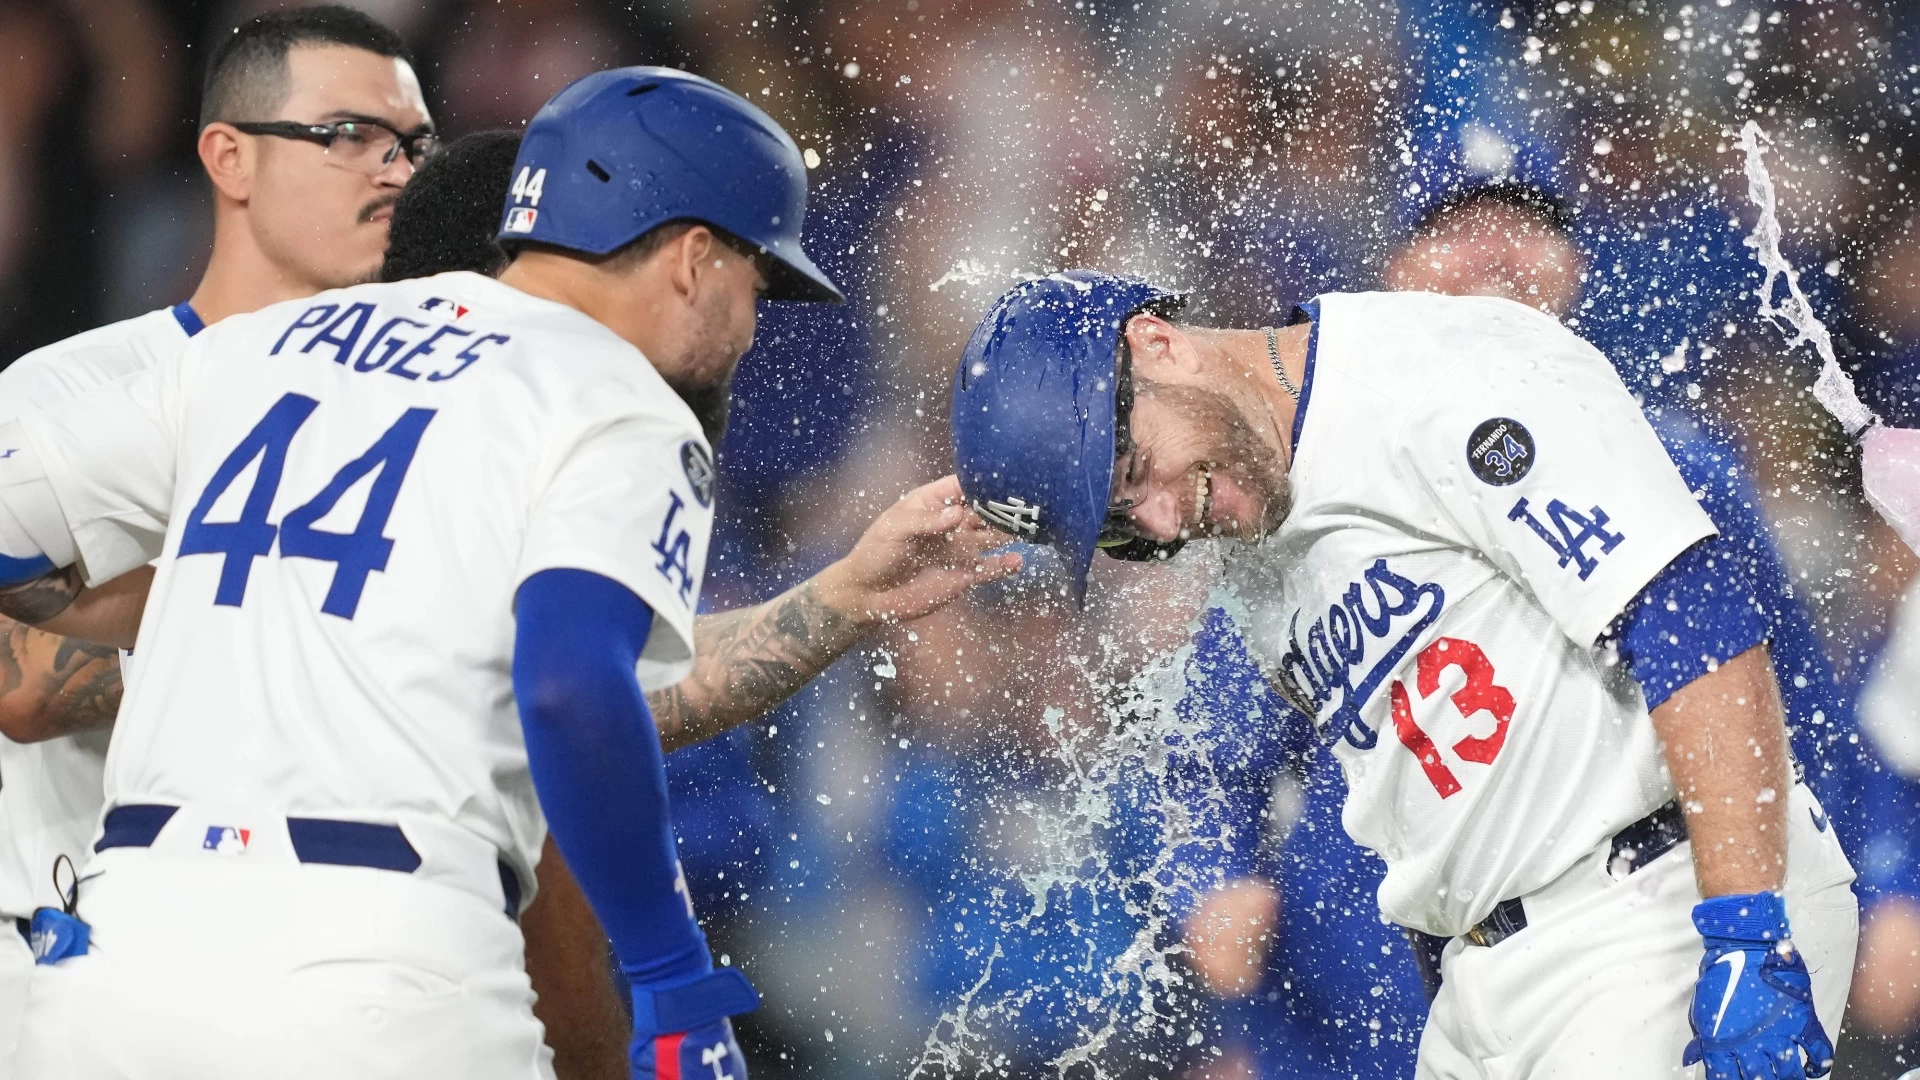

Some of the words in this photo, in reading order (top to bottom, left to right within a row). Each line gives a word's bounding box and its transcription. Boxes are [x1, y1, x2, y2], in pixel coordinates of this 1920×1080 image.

[511, 166, 547, 207] 44
[269, 302, 511, 382] PAGES
[1472, 424, 1508, 459] FERNANDO
[1485, 434, 1528, 477] 34
[176, 391, 438, 621] 44
[973, 496, 1040, 535] LA
[1507, 496, 1626, 582] LA
[651, 489, 693, 610] LA
[1391, 636, 1517, 800] 13
